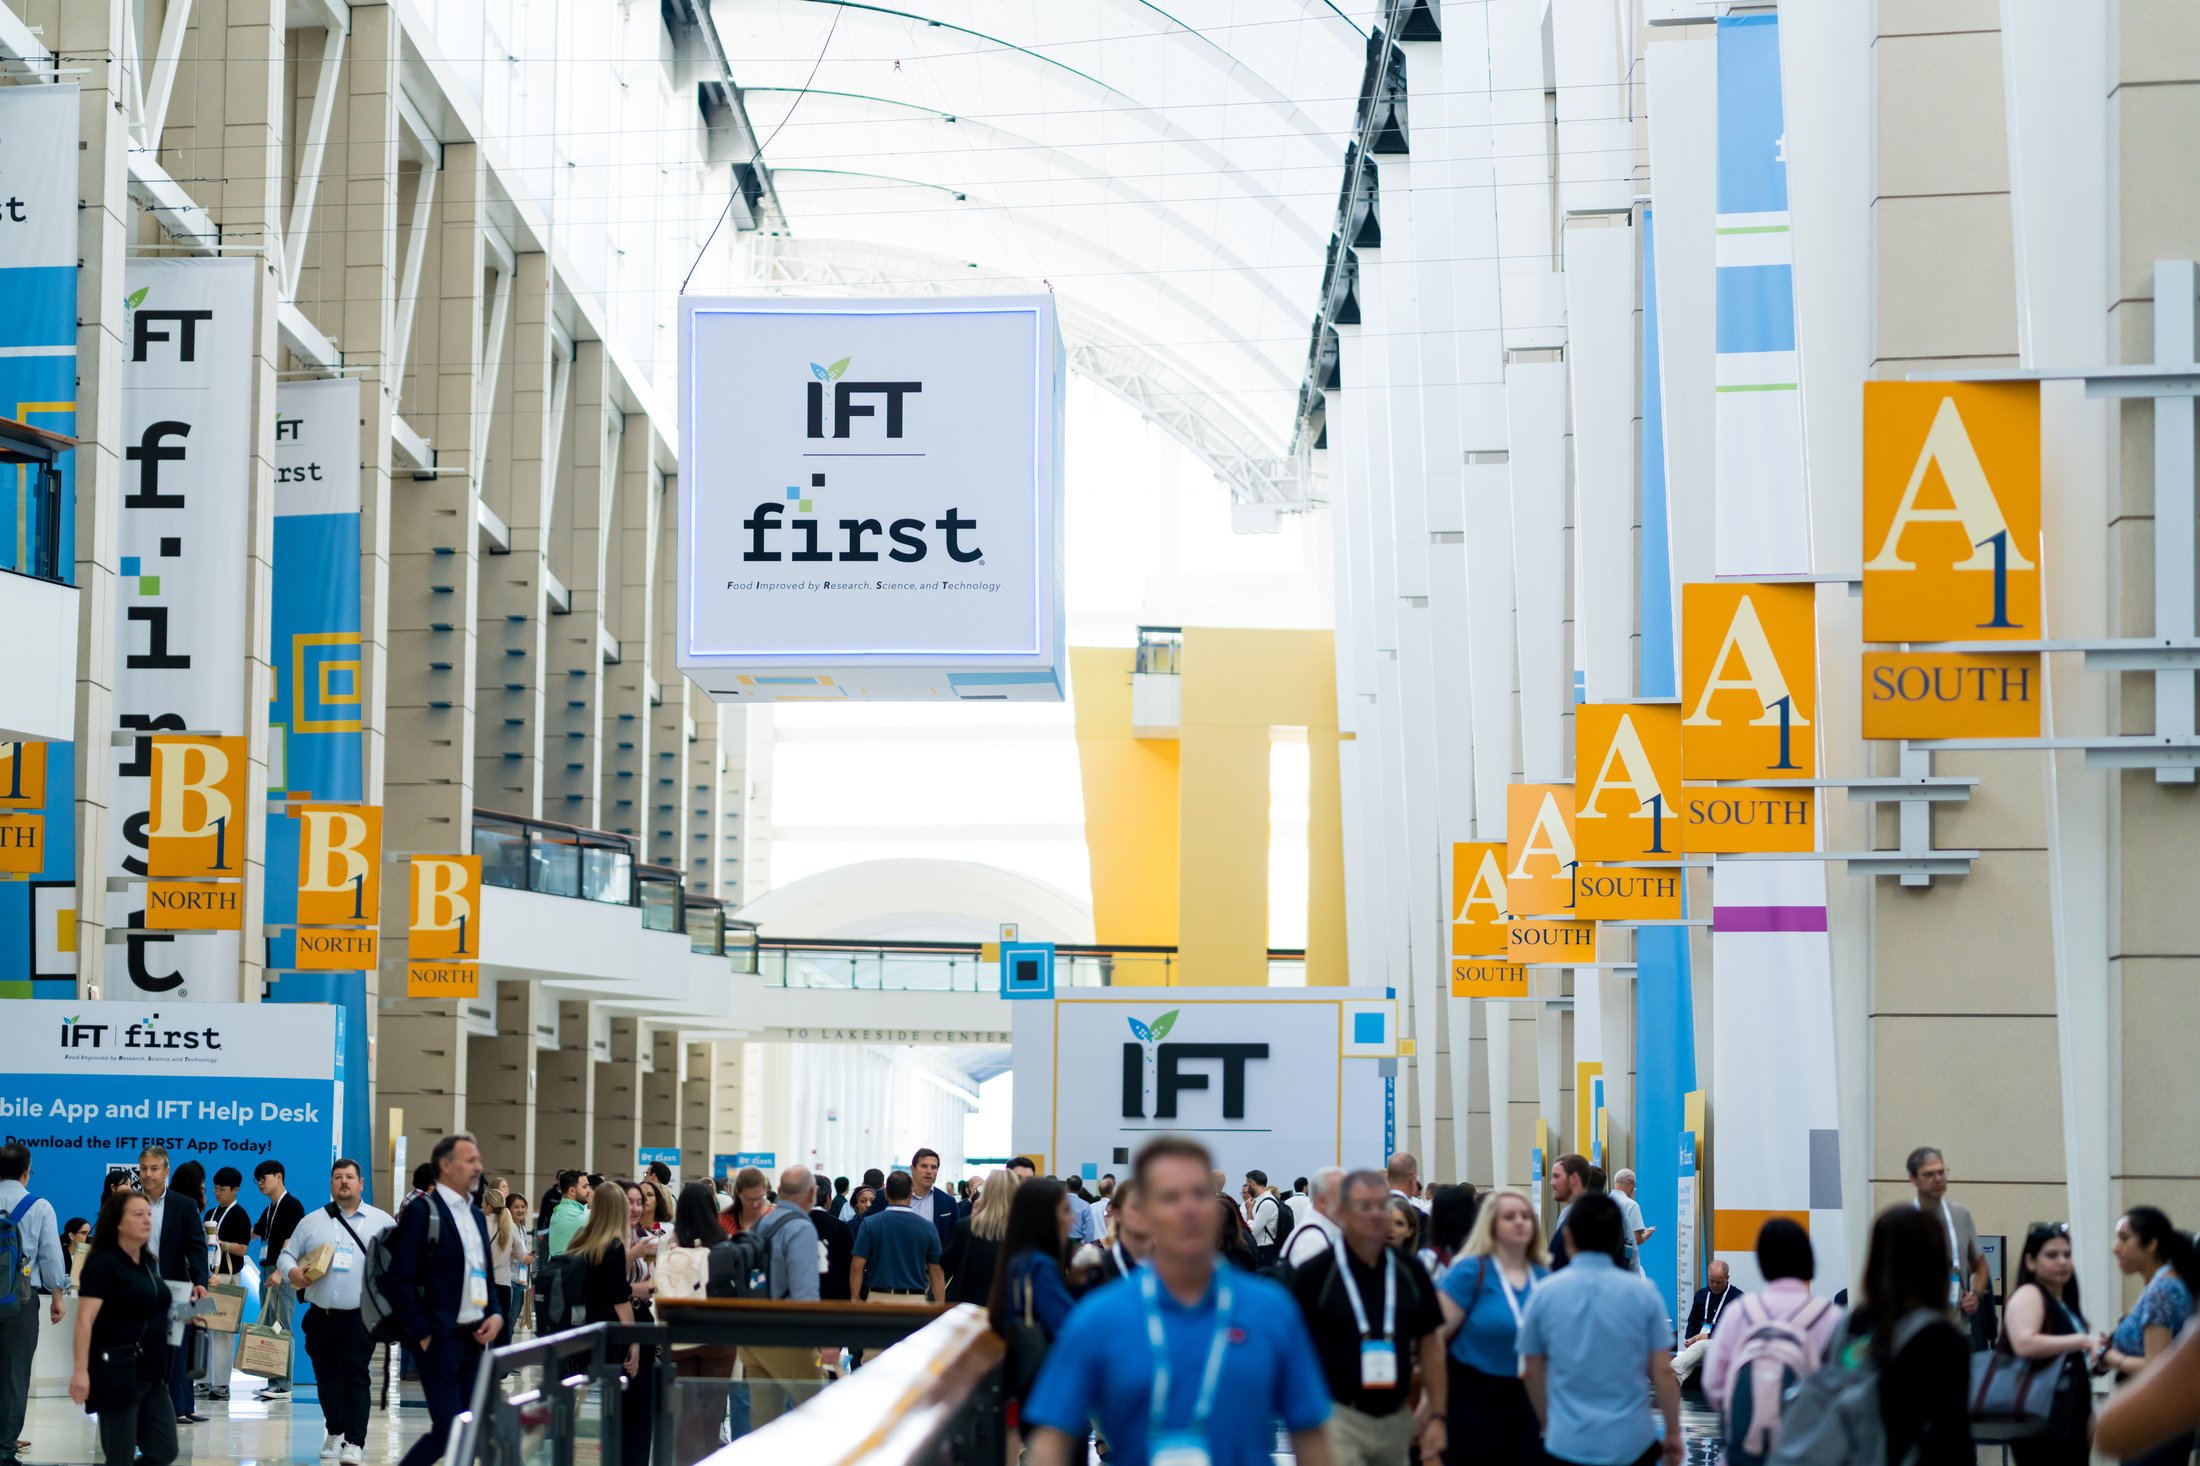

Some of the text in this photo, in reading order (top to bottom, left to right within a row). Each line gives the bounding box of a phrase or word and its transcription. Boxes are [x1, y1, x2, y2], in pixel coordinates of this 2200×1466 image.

[131, 310, 213, 362] FT
[807, 381, 922, 438] IFT
[276, 419, 304, 441] FT
[274, 462, 323, 483] rst
[727, 581, 1001, 592] Food Improved by Research, Science, and Technology
[1872, 665, 2031, 703] SOUTH
[1688, 800, 1808, 826] SOUTH
[1580, 877, 1676, 898] SOUTH
[151, 890, 237, 910] NORTH
[300, 936, 372, 953] NORTH
[1511, 928, 1592, 946] SOUTH
[411, 969, 474, 984] NORTH
[1455, 966, 1524, 982] SOUTH
[61, 1024, 108, 1048] IFT
[785, 1028, 1009, 1042] TO LAKESIDE CENTER
[1122, 1042, 1270, 1119] IFT
[0, 1097, 320, 1126] bile App and IFT Help Desk
[5, 1136, 272, 1154] Download the IFT FIRST App Today!
